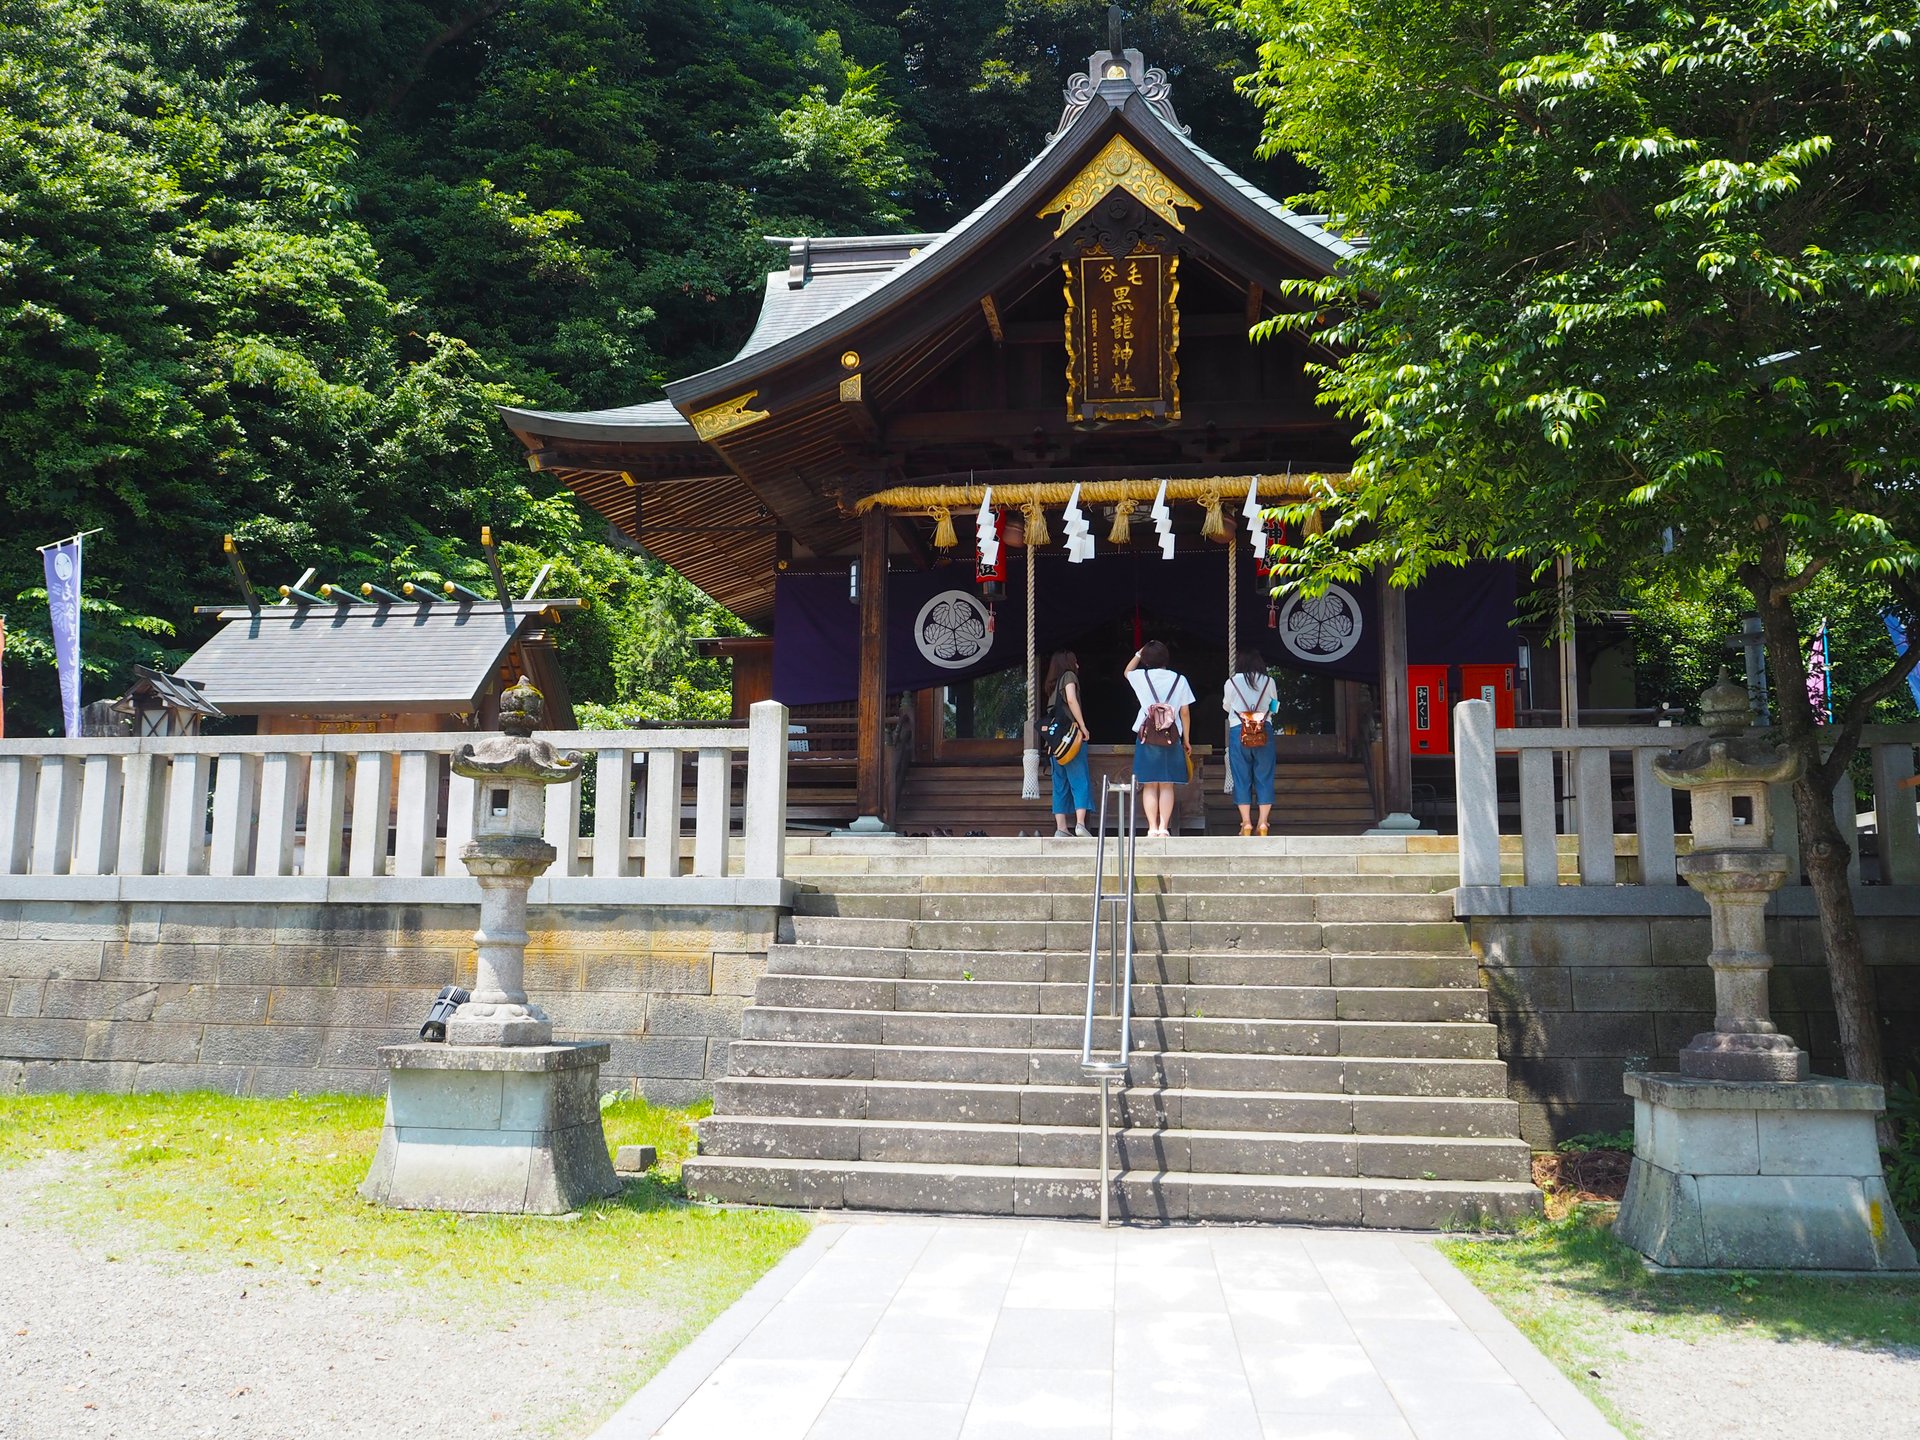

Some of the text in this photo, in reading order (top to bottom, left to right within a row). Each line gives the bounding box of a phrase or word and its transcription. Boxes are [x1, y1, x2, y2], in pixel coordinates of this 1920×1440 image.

[1110, 286, 1136, 394] 黒龍神社
[1418, 688, 1428, 728] おみくじ
